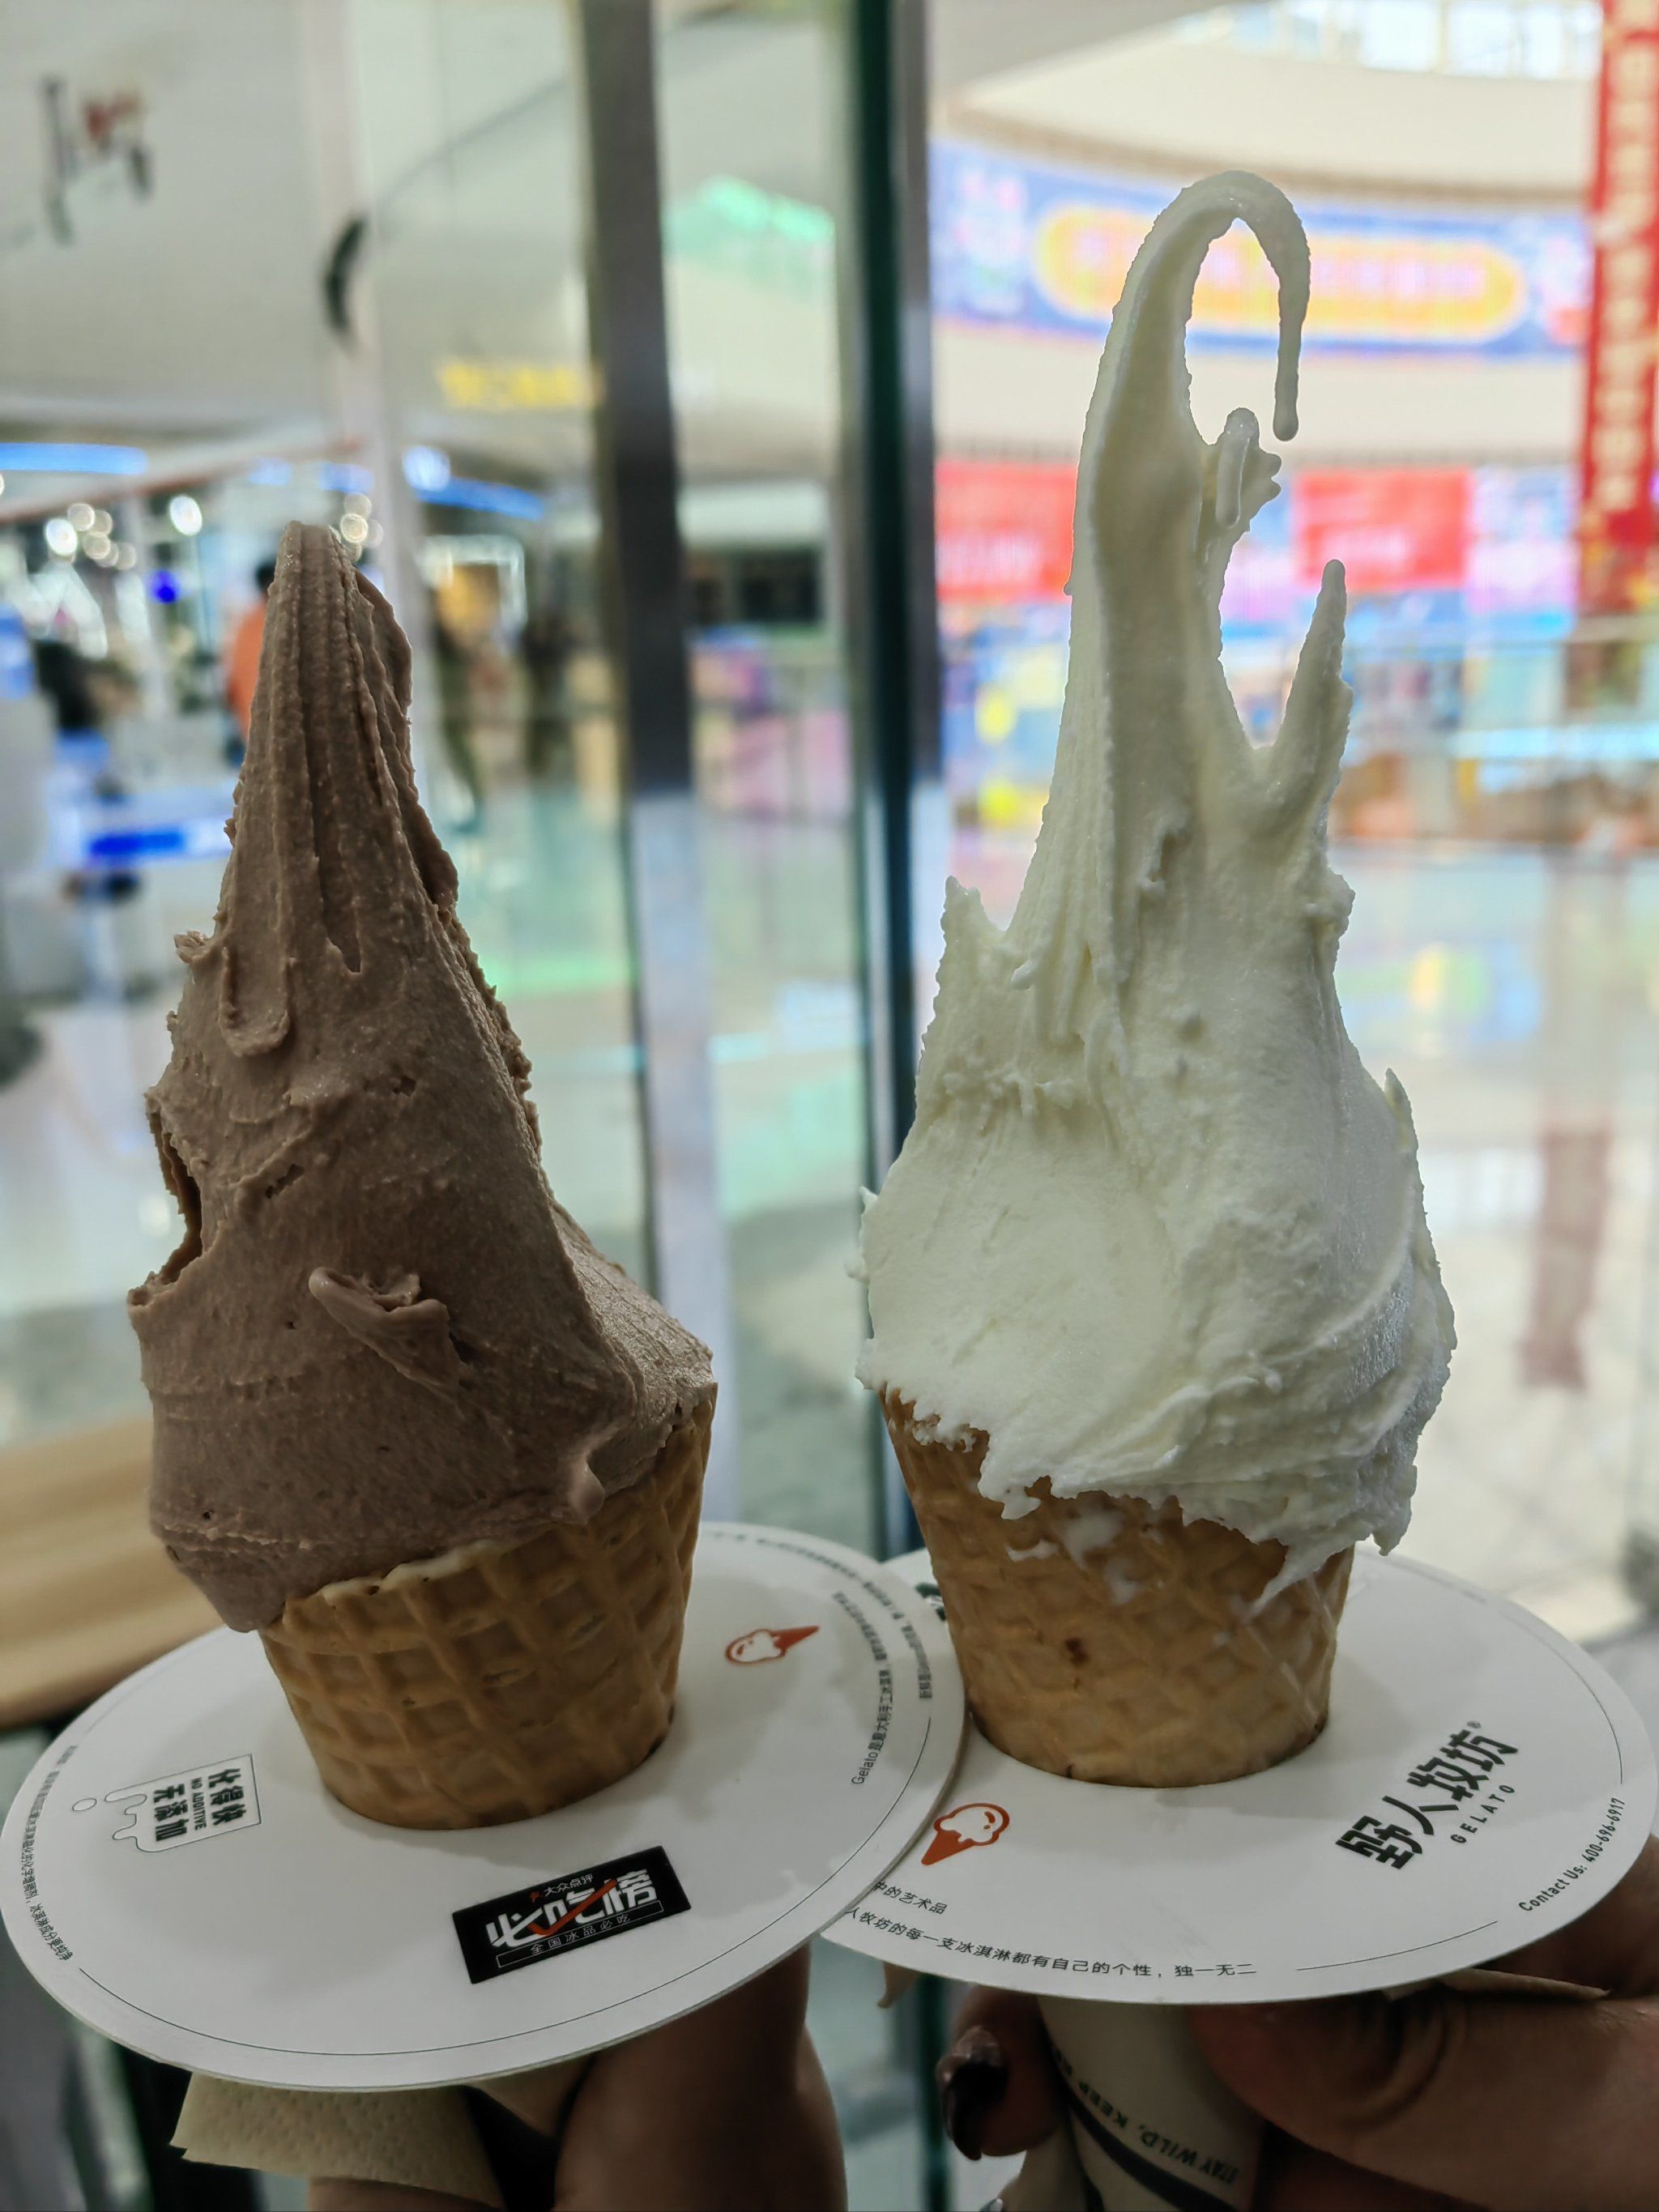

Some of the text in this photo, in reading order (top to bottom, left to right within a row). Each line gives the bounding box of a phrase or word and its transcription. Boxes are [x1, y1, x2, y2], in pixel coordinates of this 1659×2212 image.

[153, 1783, 188, 1842] 无添加
[191, 1777, 207, 1831] NO ADDITIVE
[1335, 1728, 1518, 1869] 野人牧坊
[1451, 1784, 1516, 1844] GELATO
[544, 1872, 595, 1896] 大众点评
[1519, 1797, 1626, 1912] Contact Us: 400-696-6917
[485, 1869, 658, 1948] 必吃榜
[530, 1913, 631, 1955] 全国冰品必吃
